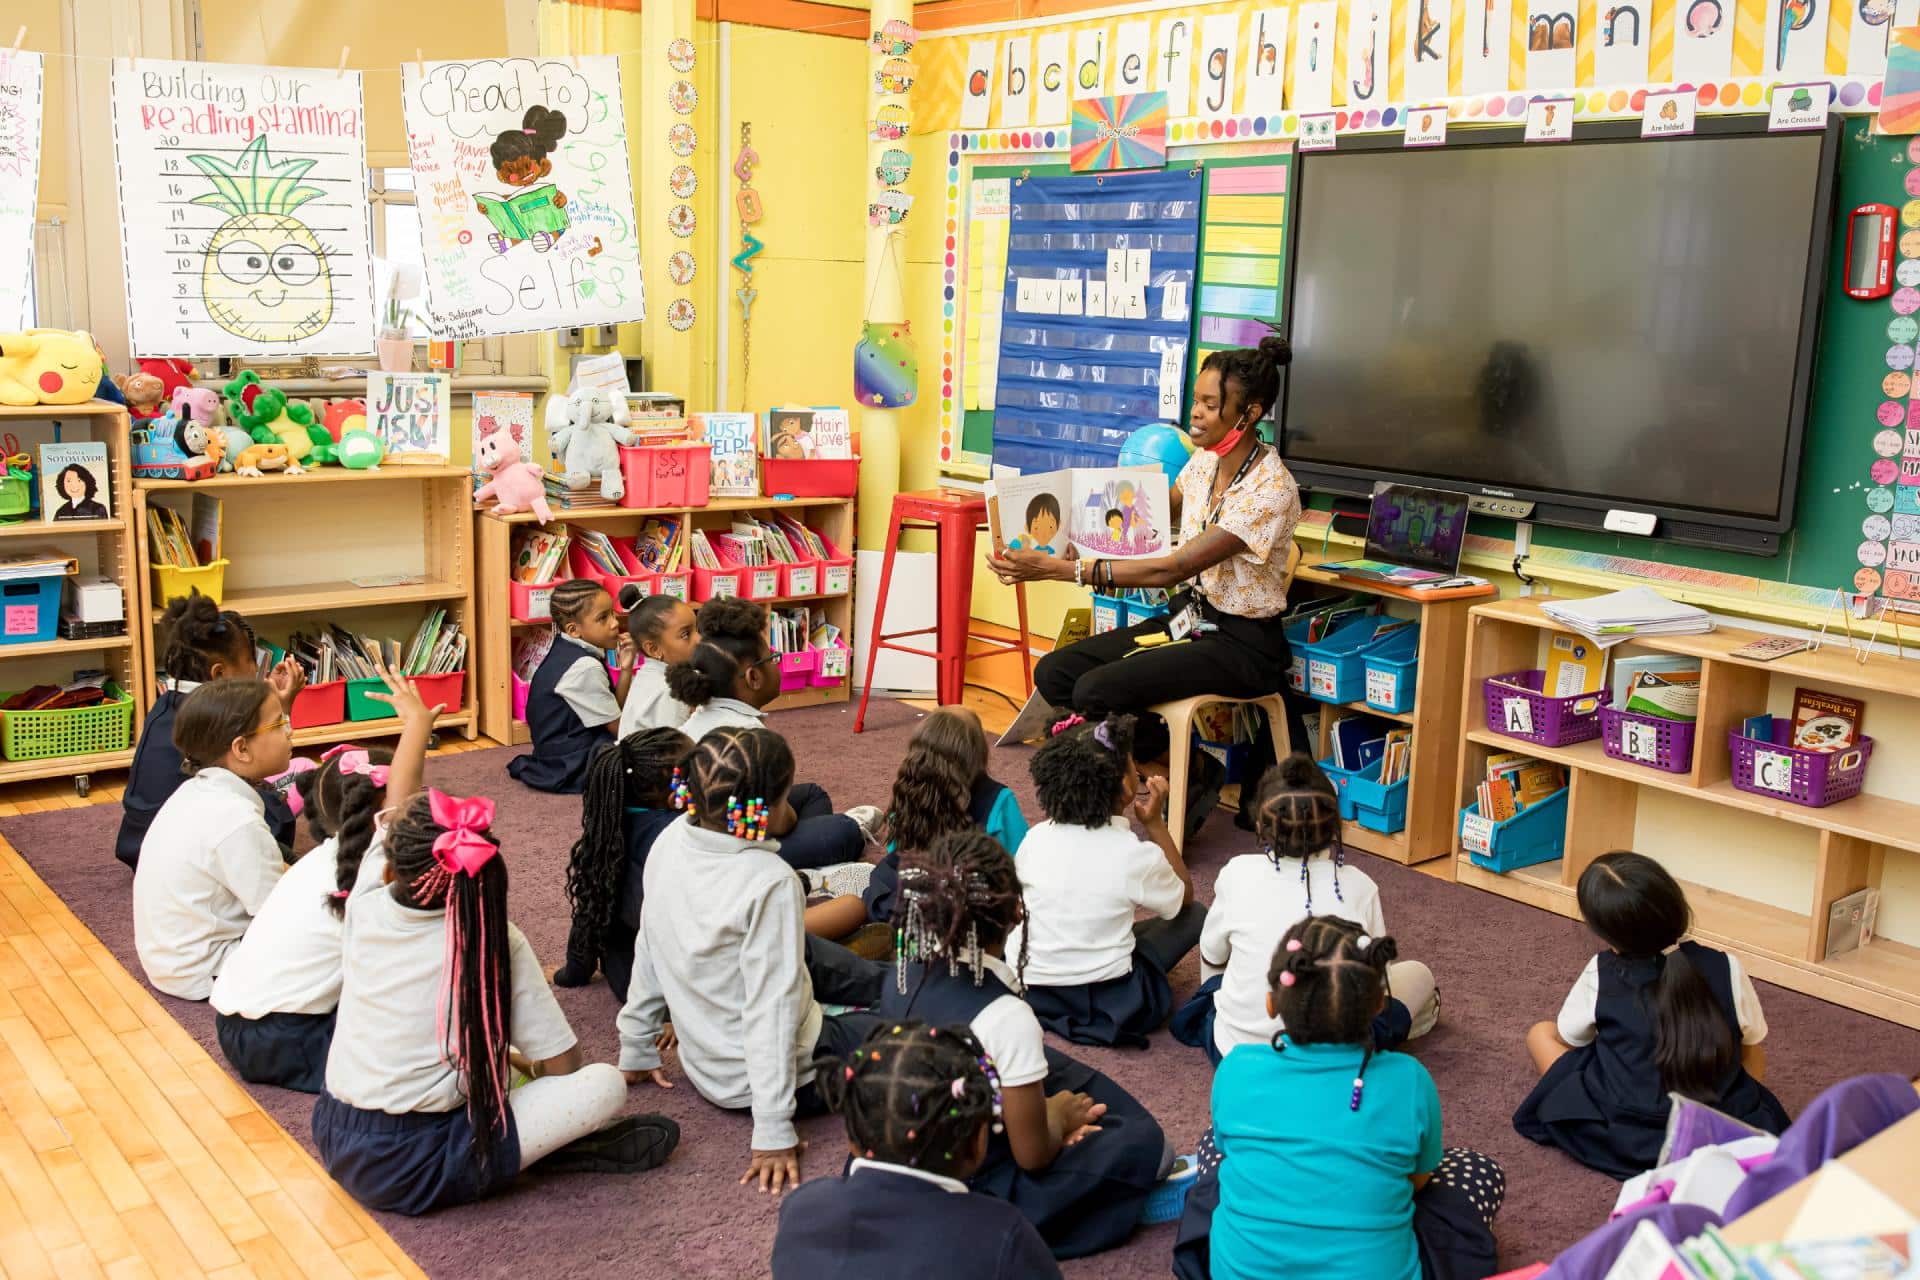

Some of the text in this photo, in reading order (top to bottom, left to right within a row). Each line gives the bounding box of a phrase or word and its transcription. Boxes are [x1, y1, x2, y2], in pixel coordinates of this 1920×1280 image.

[969, 69, 989, 97] a
[1007, 41, 1026, 96] b
[1043, 62, 1062, 92] c
[1078, 31, 1102, 89] d
[1122, 53, 1141, 85] e
[1163, 21, 1187, 82] f
[1206, 46, 1229, 112] g
[1256, 13, 1276, 77] h
[1309, 21, 1320, 72] i
[1353, 13, 1379, 100] j
[1415, 0, 1441, 62] k
[1529, 12, 1576, 52] m
[1604, 5, 1640, 47] n
[1686, 0, 1722, 38] o
[1776, 0, 1816, 71] p
[142, 68, 313, 113] Building Our
[445, 66, 573, 114] Read to
[141, 104, 254, 142] Reading
[1777, 114, 1821, 125] Are Crossed
[1651, 124, 1663, 133] Are
[158, 134, 180, 147] 20
[164, 159, 180, 172] 18
[168, 184, 183, 197] 16
[171, 208, 186, 222] 14
[173, 232, 191, 246] 12
[176, 257, 191, 270] 10
[1113, 257, 1141, 273] s t
[177, 282, 188, 296] 8
[479, 254, 585, 317] Self
[1023, 289, 1029, 301] u
[1045, 290, 1052, 302] v
[1066, 291, 1078, 303] w
[1093, 293, 1100, 303] x
[1112, 295, 1120, 313] y
[1130, 295, 1137, 307] z
[179, 304, 189, 316] 6
[181, 327, 190, 340] 4
[376, 376, 442, 413] JUST
[1162, 384, 1177, 406] ch
[703, 418, 748, 440] JUST
[814, 416, 844, 433] Hair
[814, 431, 845, 448] Love
[46, 454, 104, 463] SOTOMAYOR
[1800, 697, 1841, 714] Breakfast
[1842, 706, 1856, 717] For
[1510, 706, 1523, 730] A
[1629, 731, 1640, 754] B
[1761, 762, 1773, 786] C
